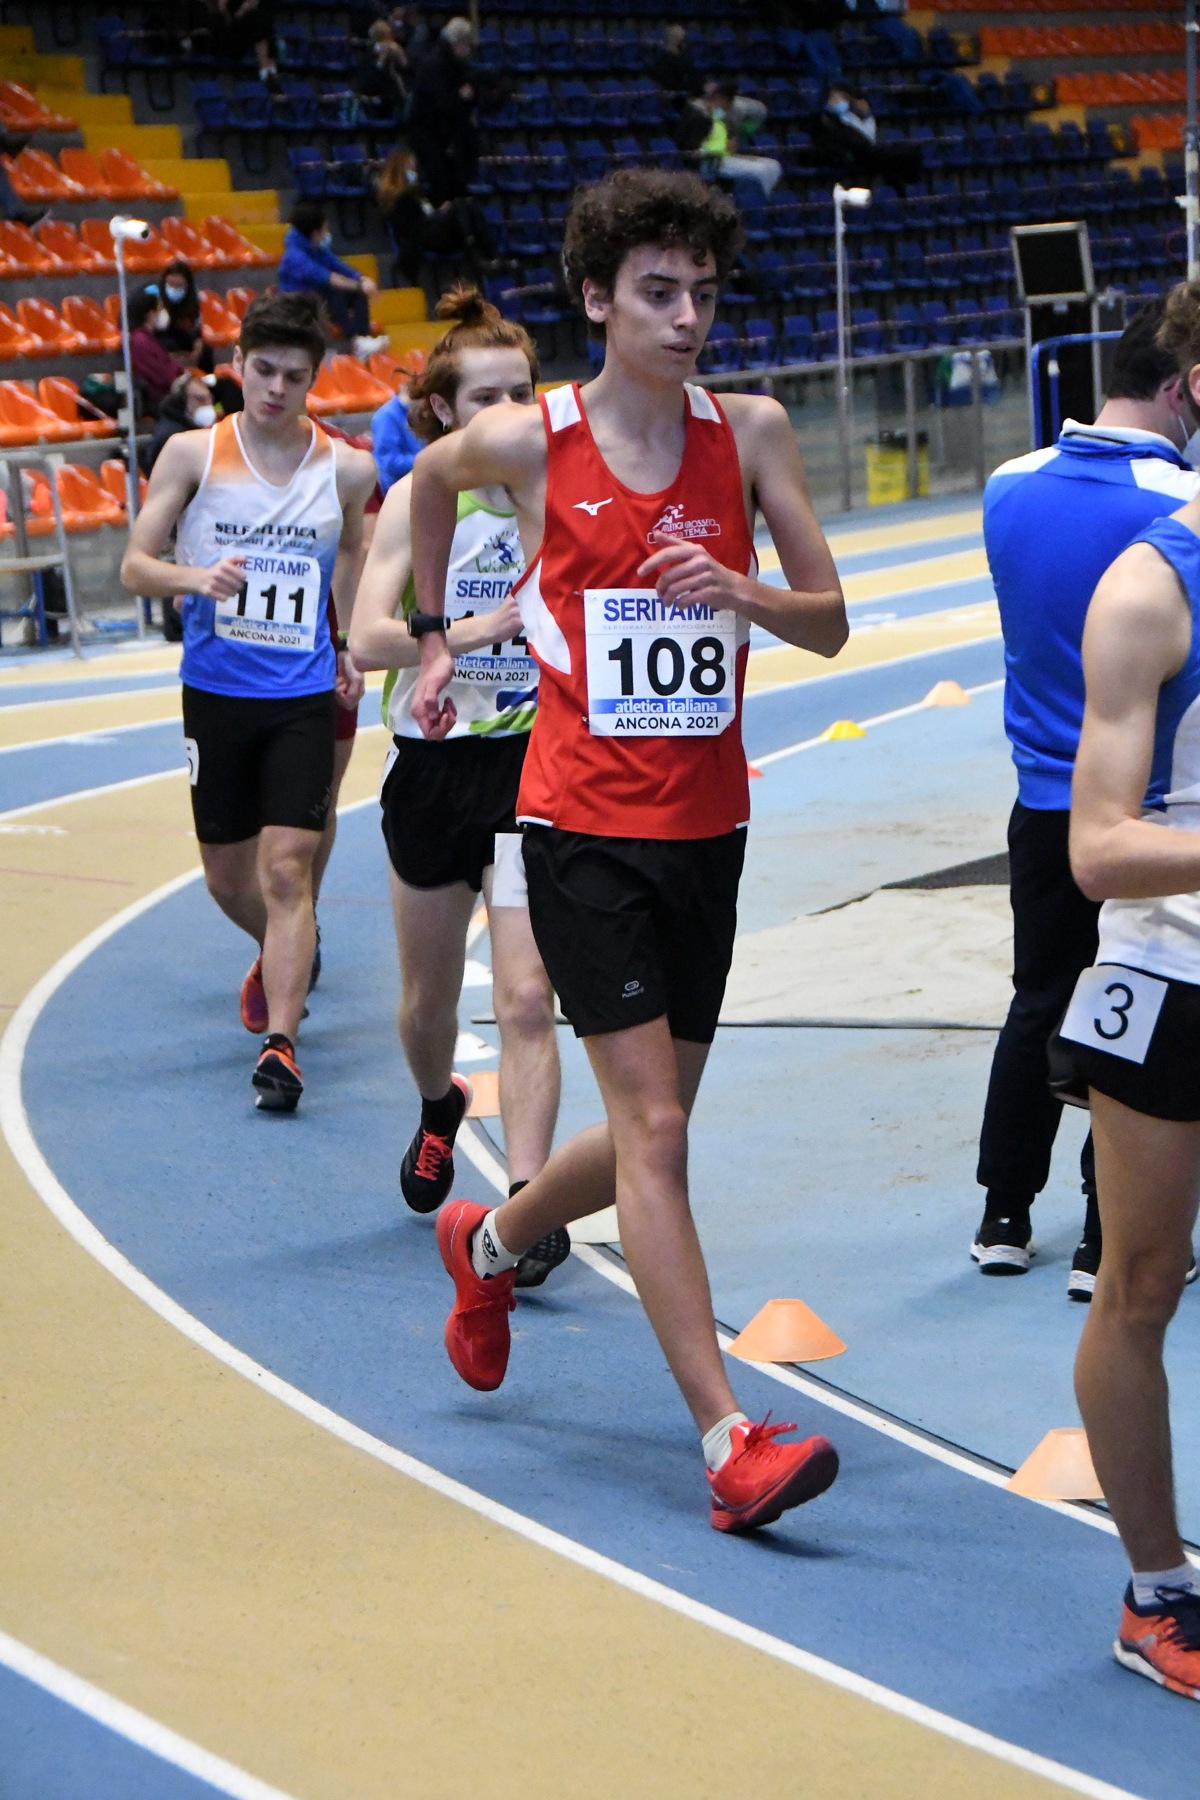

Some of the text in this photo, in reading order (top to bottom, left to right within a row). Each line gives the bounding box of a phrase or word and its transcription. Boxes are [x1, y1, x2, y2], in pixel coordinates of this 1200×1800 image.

[237, 556, 311, 577] ERITAMP
[235, 581, 305, 623] 111
[229, 628, 301, 645] ANCONA 2021
[493, 658, 529, 669] italiana
[608, 636, 726, 696] 108
[505, 671, 529, 681] 2021
[615, 697, 718, 714] atletica italiana
[614, 716, 719, 730] ANCONA 2021
[1094, 982, 1134, 1040] 3
